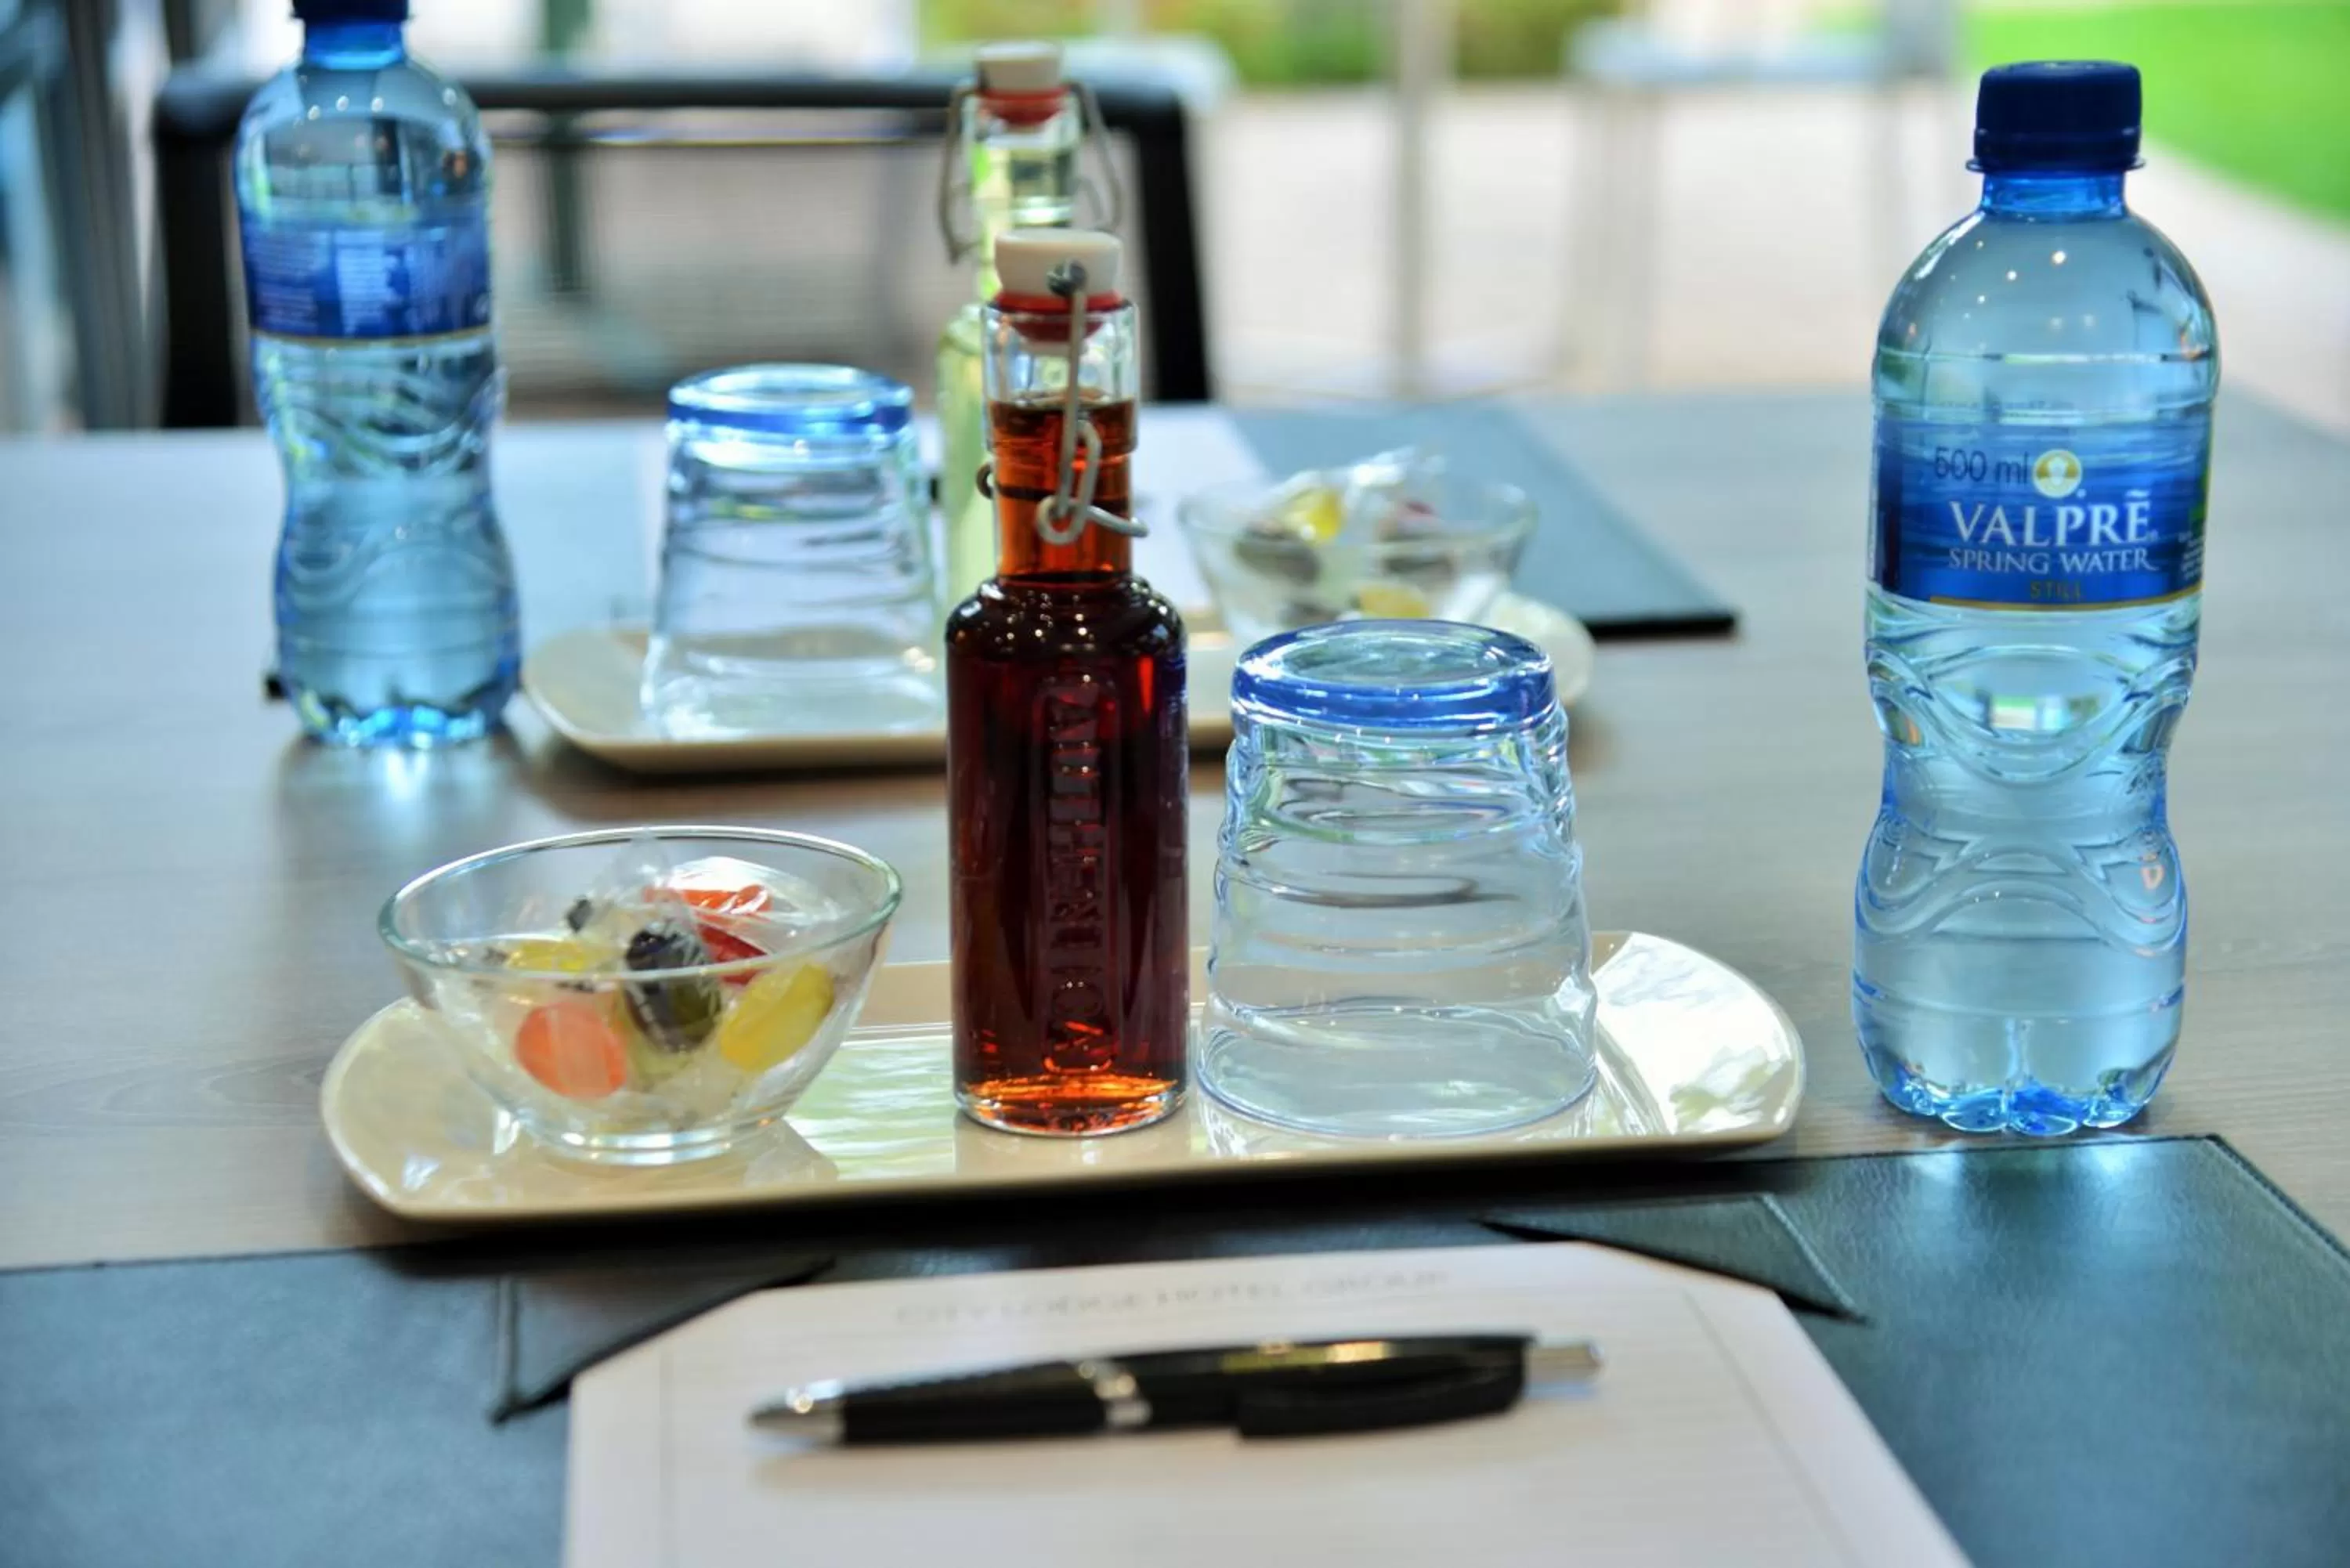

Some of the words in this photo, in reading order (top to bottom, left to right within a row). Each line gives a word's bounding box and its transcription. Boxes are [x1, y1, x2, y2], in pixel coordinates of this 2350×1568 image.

[1933, 446, 1987, 483] 500
[1996, 452, 2029, 484] ml
[1949, 547, 2051, 575] SPRING
[2060, 547, 2160, 574] WATER
[2030, 580, 2082, 601] STILL
